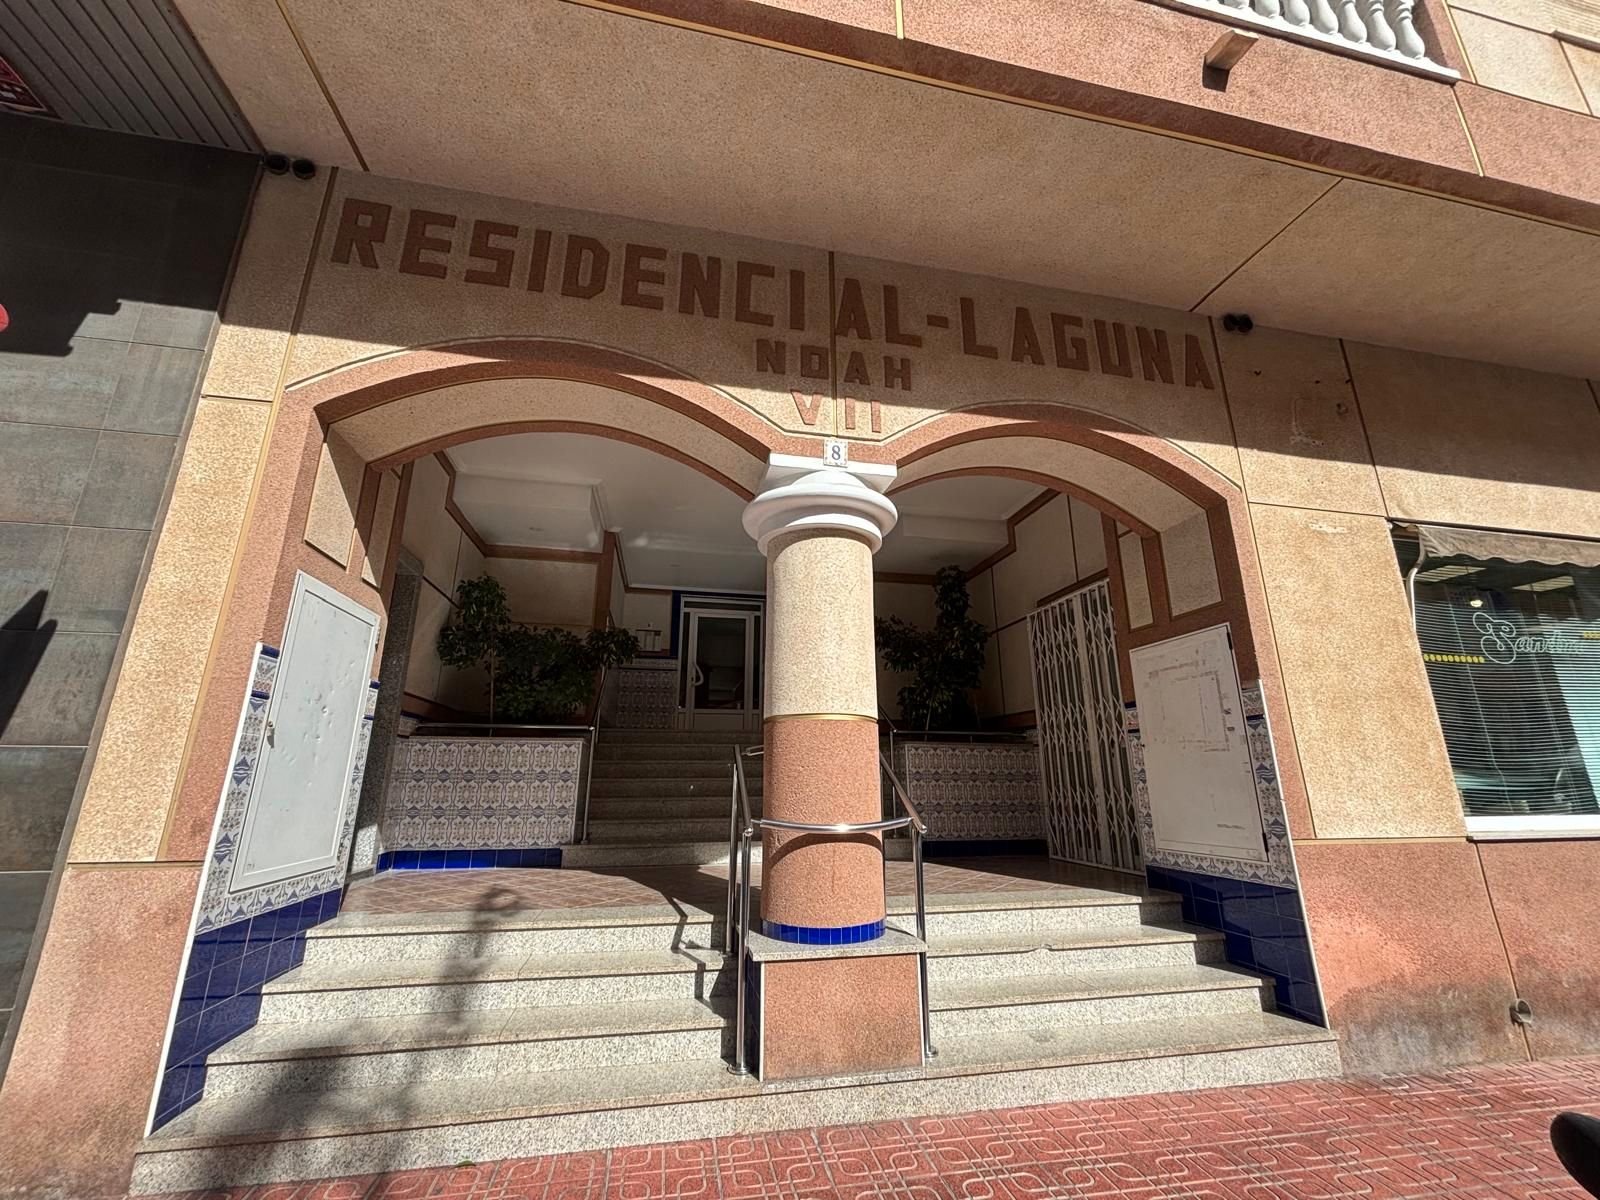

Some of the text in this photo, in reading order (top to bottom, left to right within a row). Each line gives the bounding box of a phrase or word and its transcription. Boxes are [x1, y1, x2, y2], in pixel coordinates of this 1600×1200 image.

[756, 338, 911, 391] NOAH
[790, 389, 881, 433] VII
[831, 445, 841, 461] 8
